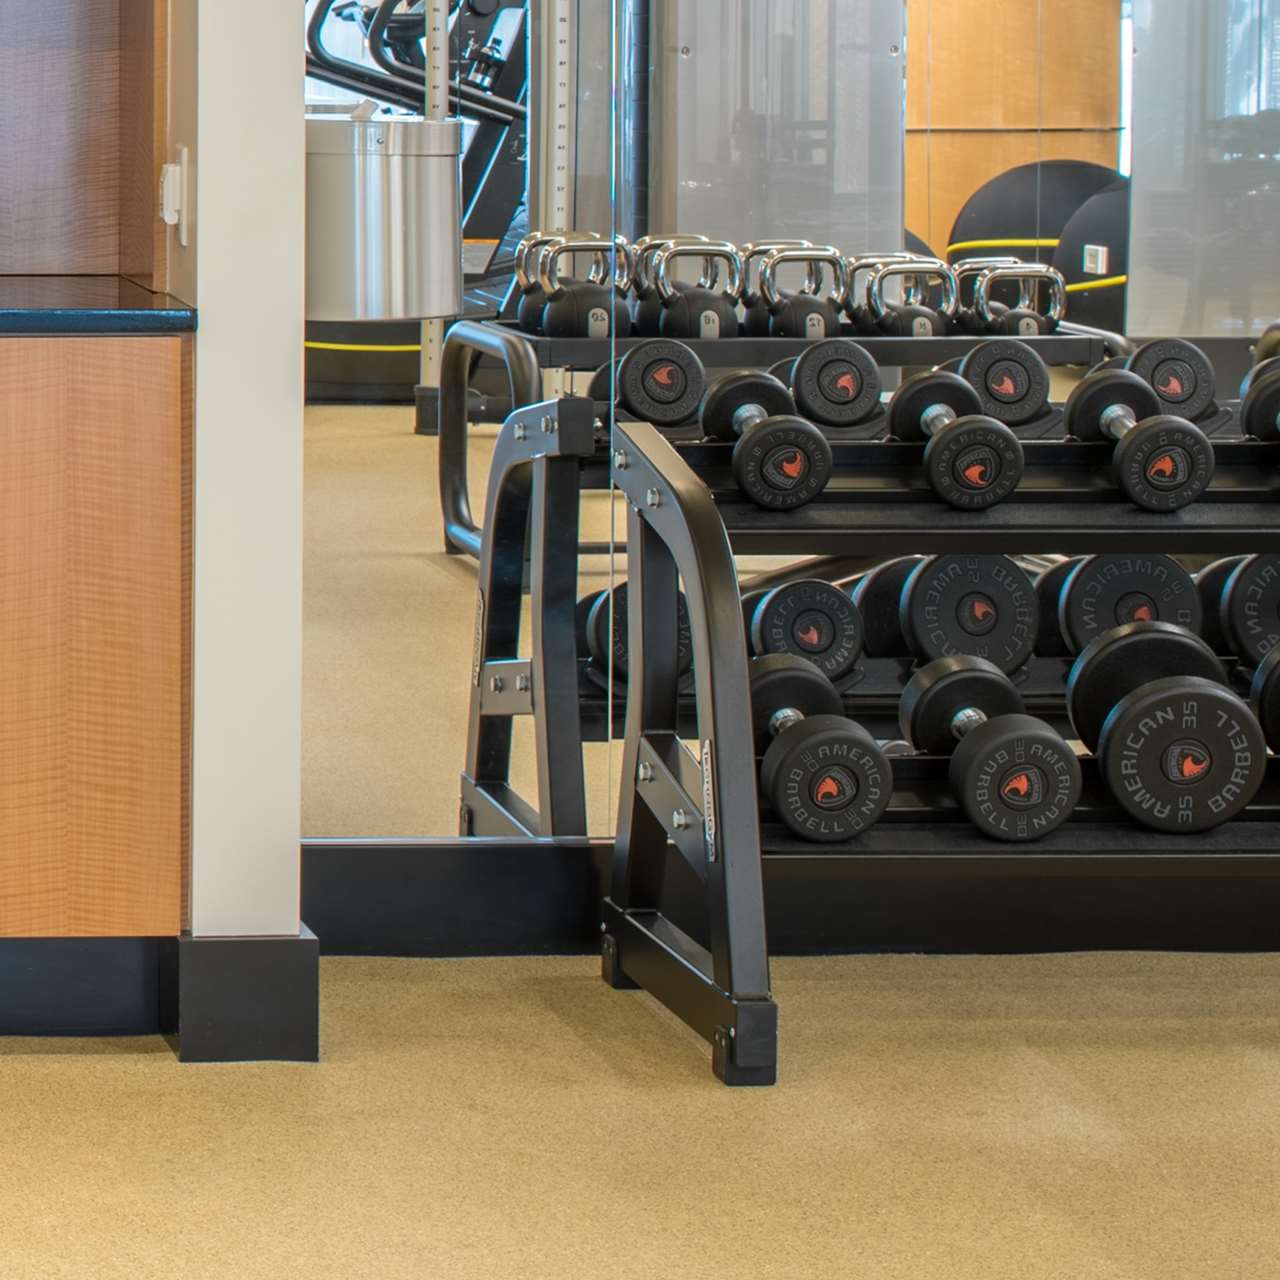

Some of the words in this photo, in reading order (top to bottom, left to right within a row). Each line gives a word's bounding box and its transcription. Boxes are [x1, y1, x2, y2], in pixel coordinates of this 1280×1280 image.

[938, 431, 1006, 472] AMERICAN
[1182, 701, 1197, 729] 35
[801, 750, 820, 772] 30
[1014, 736, 1025, 762] 30
[1121, 706, 1176, 819] AMERICAN
[1207, 710, 1252, 813] BARBELL
[818, 743, 881, 815] AMERICAN
[976, 749, 1010, 832] BARBELL
[1030, 743, 1071, 829] AMERICAN
[786, 768, 845, 833] BARBELL
[843, 808, 865, 830] 30
[1178, 795, 1193, 824] 35
[1016, 814, 1028, 838] 30
